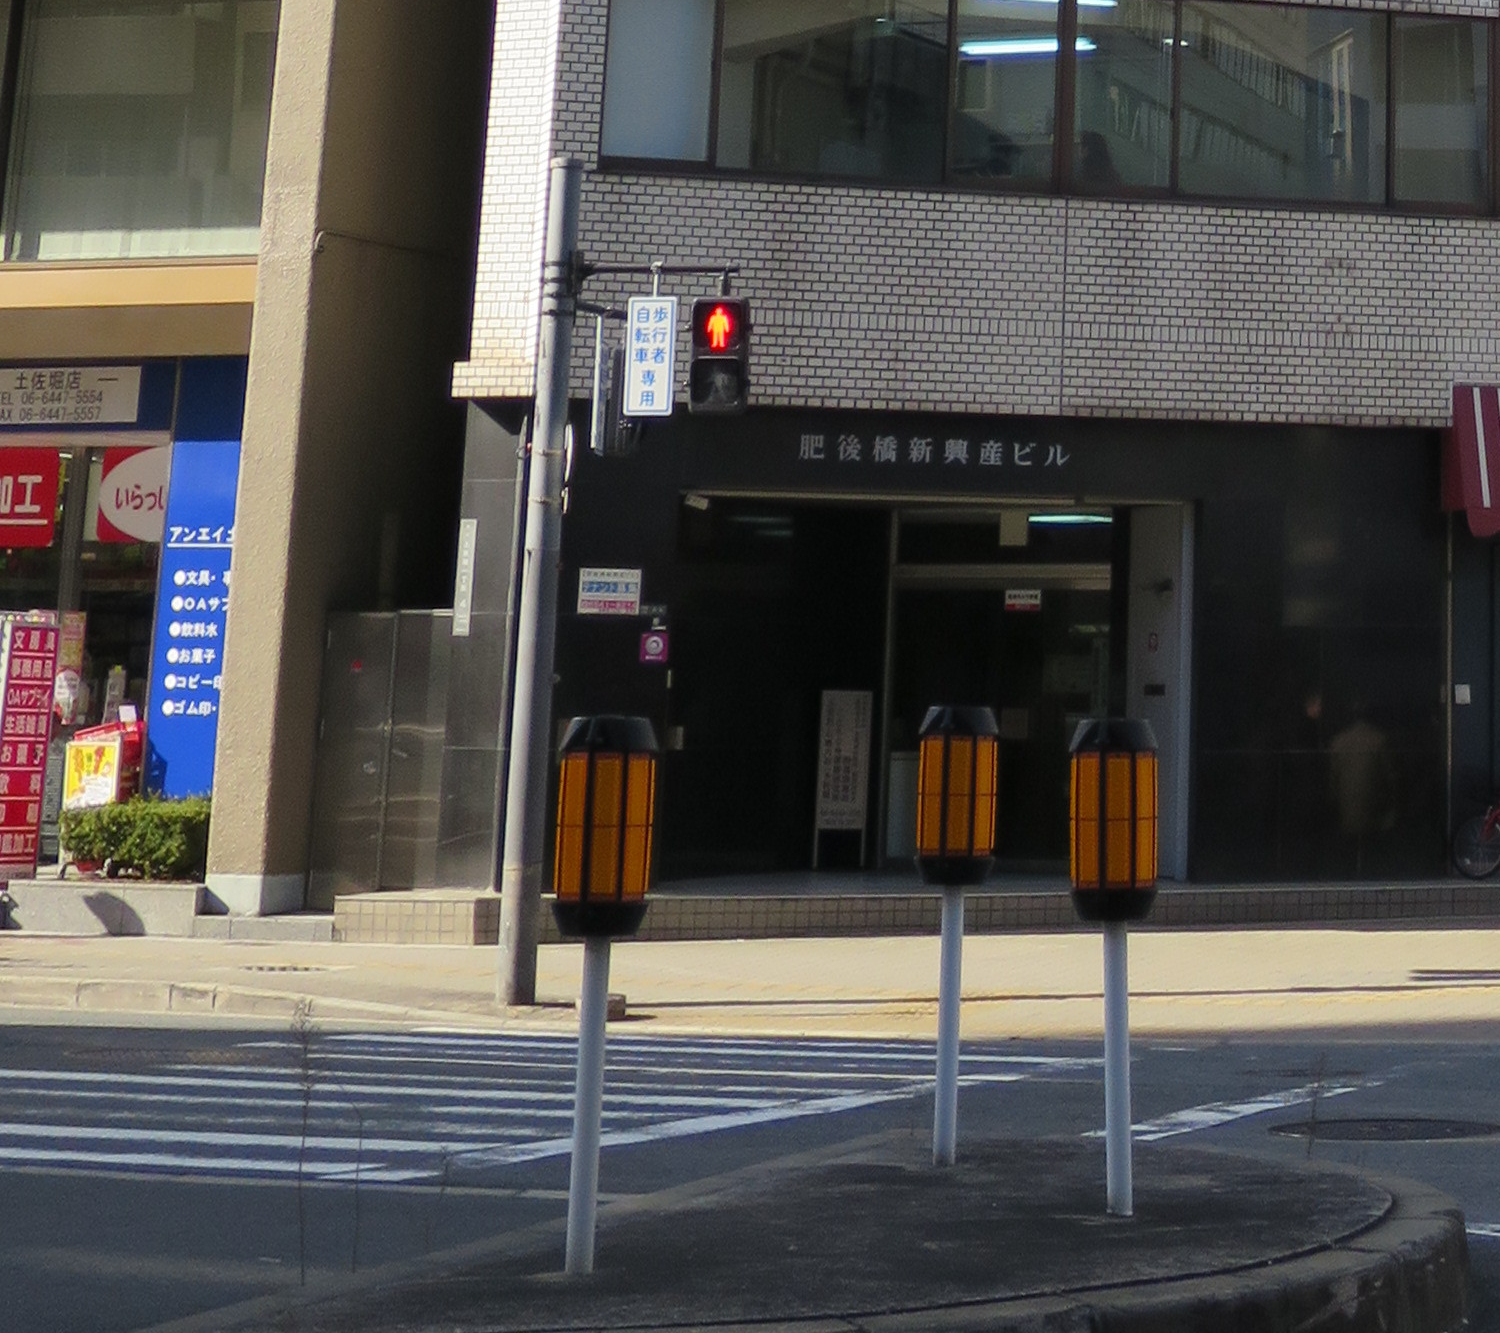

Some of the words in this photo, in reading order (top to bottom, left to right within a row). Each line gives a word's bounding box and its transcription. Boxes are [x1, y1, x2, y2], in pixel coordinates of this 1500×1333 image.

[634, 306, 650, 364] 自転車
[652, 306, 668, 364] 歩行者
[0, 392, 14, 406] EL
[640, 370, 655, 406] 専用
[0, 408, 12, 421] AX
[799, 434, 1071, 467] 肥後橋新興産ビル
